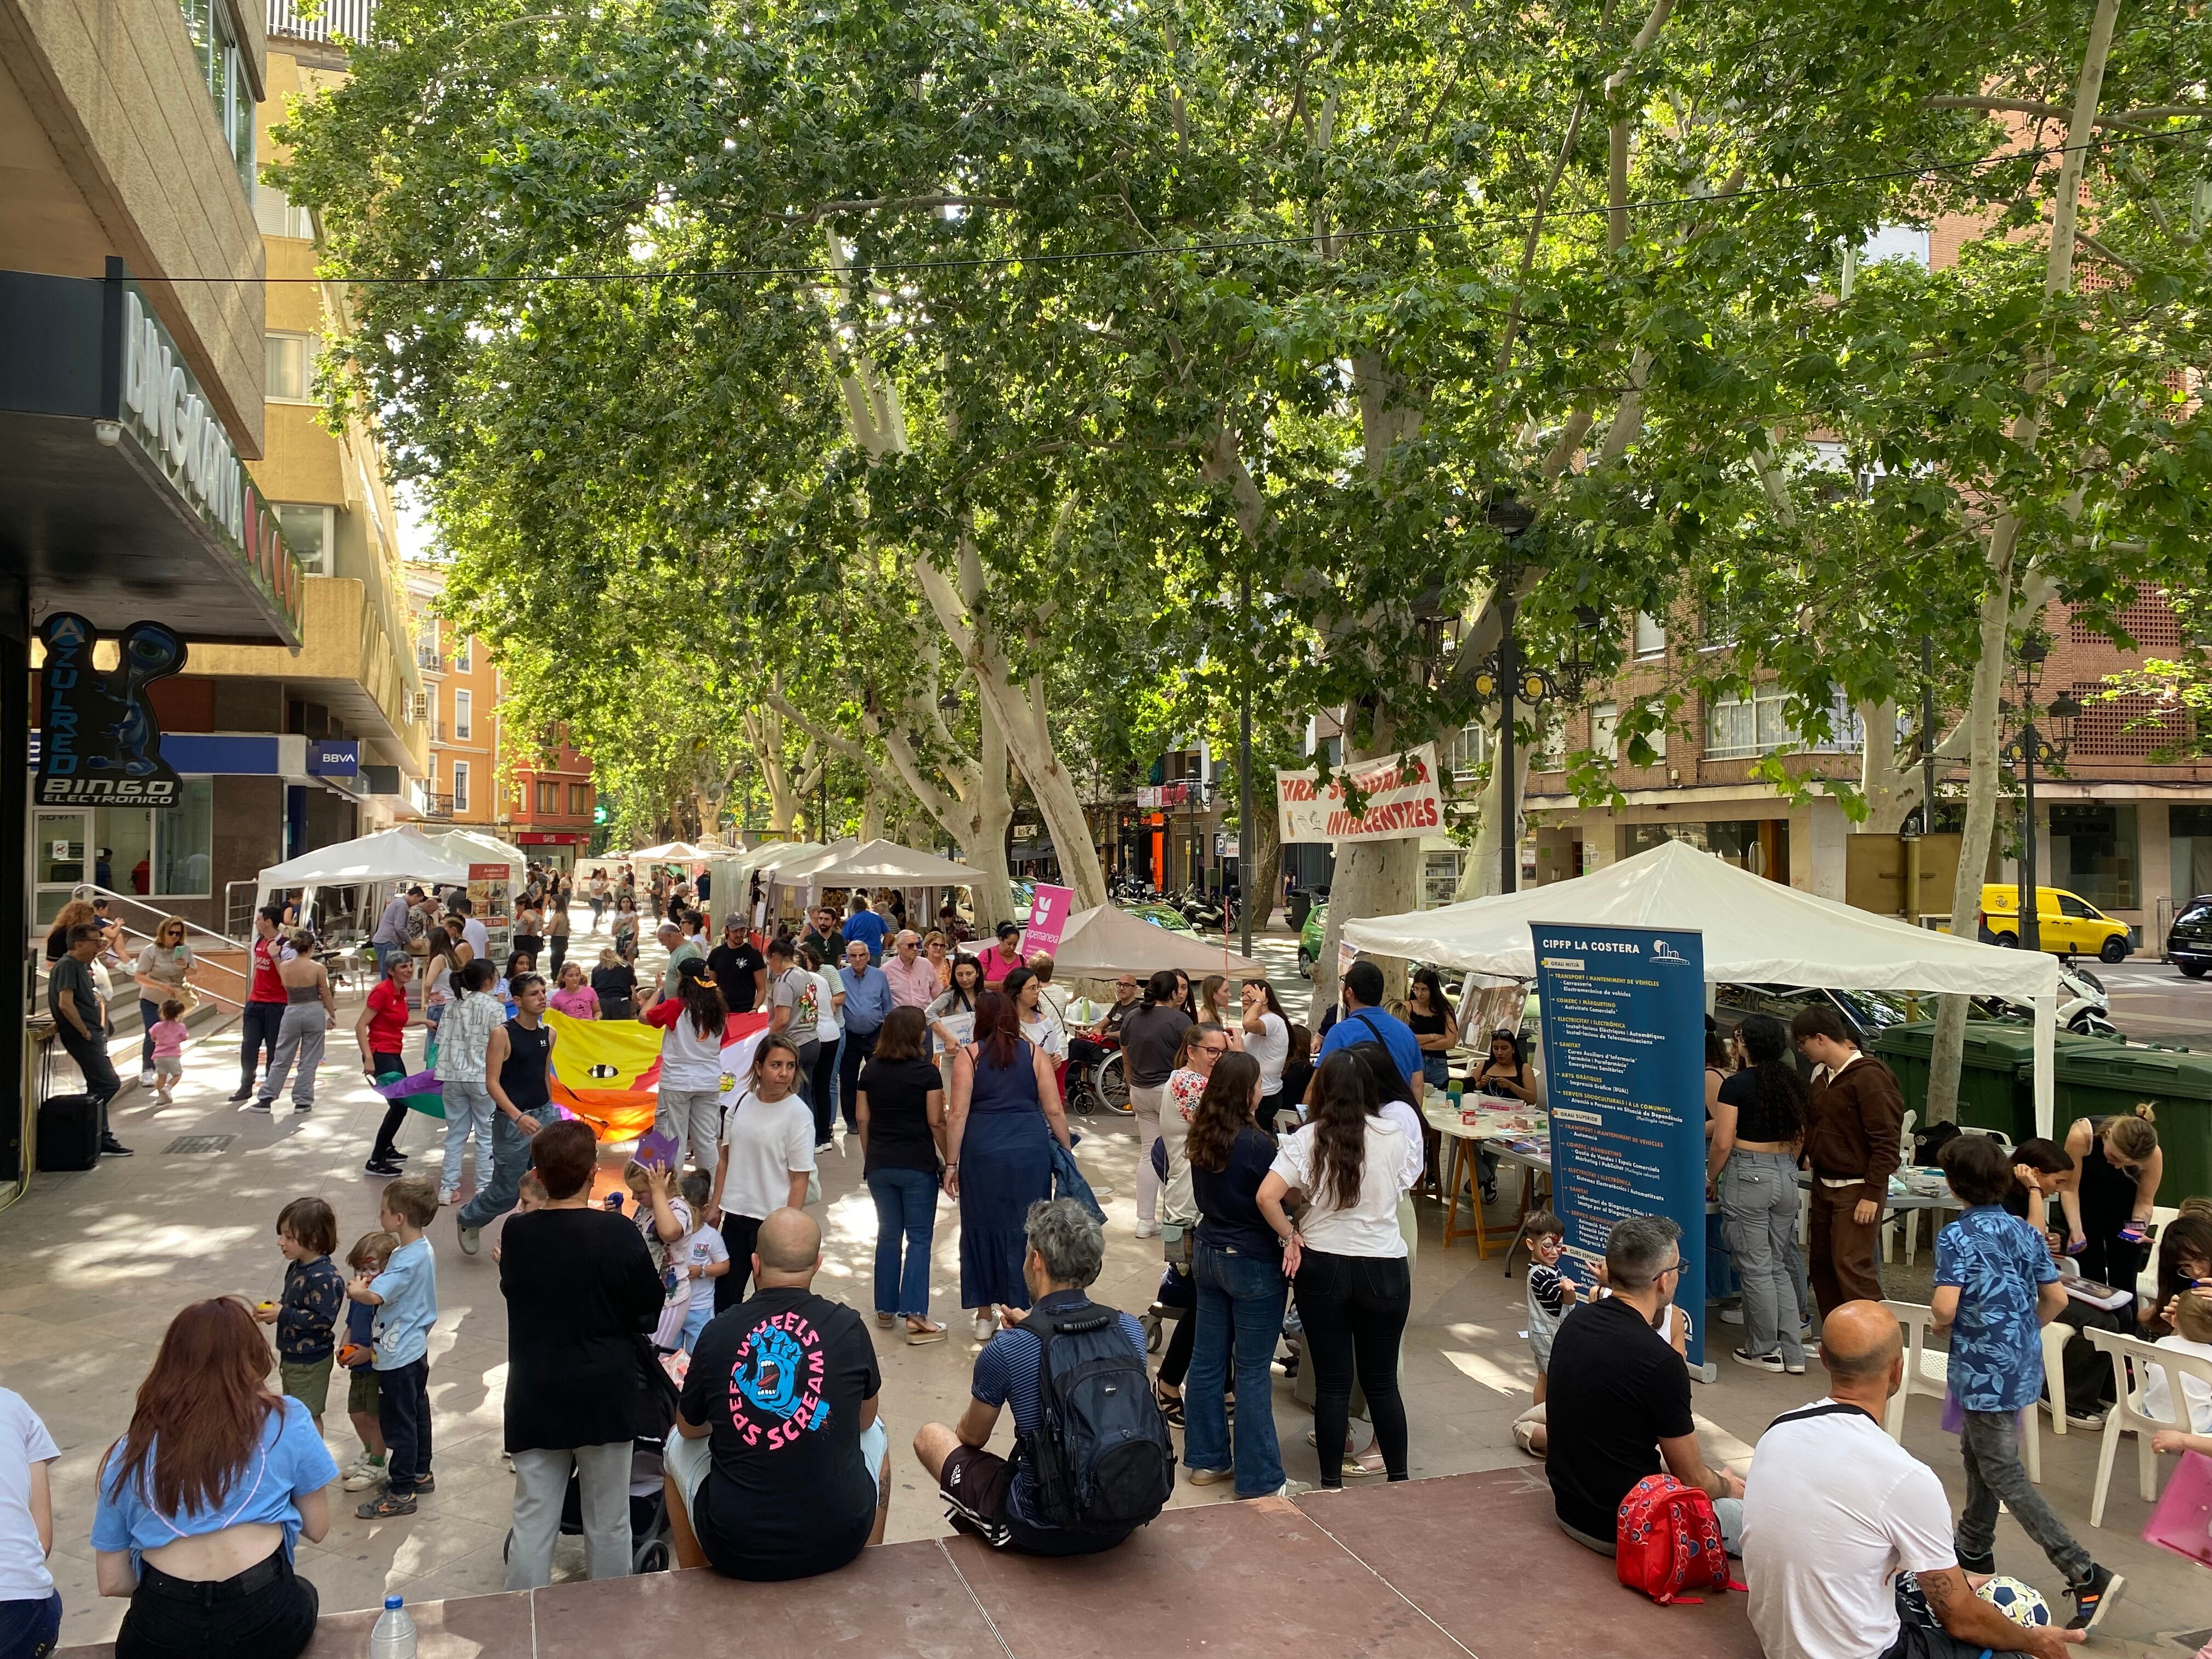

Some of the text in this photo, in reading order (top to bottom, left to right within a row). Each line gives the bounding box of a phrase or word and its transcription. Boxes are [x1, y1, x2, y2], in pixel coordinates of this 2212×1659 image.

[322, 753, 356, 764] BBVA
[43, 778, 174, 795] BINGO
[43, 794, 173, 804] ELECTRONICO
[1327, 798, 1438, 836] INTERCENTRES
[1027, 929, 1059, 943] apemanexa
[1543, 939, 1640, 953] CIPFP LA COSTERA
[1589, 975, 1626, 984] MANTENIMENT
[1594, 1019, 1626, 1029] ELECTRÒNICA
[1583, 1050, 1604, 1058] Auxiliars
[1612, 1086, 1629, 1095] (DUAL)
[1584, 1092, 1624, 1105] SOCIOCULTURALS
[1640, 1103, 1672, 1113] COMUNITAT
[1576, 1113, 1598, 1122] SUPERIOR
[1594, 1102, 1616, 1110] Persones
[1651, 1111, 1683, 1123] Dependència
[1565, 1124, 1593, 1133] TRANSPORT
[1597, 1129, 1632, 1142] MANTENIMENT
[1639, 1138, 1663, 1148] VEHICLES
[1597, 1154, 1614, 1162] Vendes
[1618, 1158, 1632, 1167] Espais
[1633, 1161, 1660, 1173] Comercials
[1601, 1161, 1624, 1171] Publicitat
[1569, 1186, 1588, 1195] SANITAT
[1576, 1175, 1595, 1184] Sistemes
[1630, 1188, 1664, 1201] Automatitzats
[1577, 1194, 1600, 1205] Laboratori
[1577, 1200, 1593, 1209] Imatge
[1578, 1218, 1598, 1228] Animació
[1578, 1224, 1597, 1234] Educació
[1570, 1249, 1581, 1257] CURS
[767, 1350, 825, 1451] SCREAM
